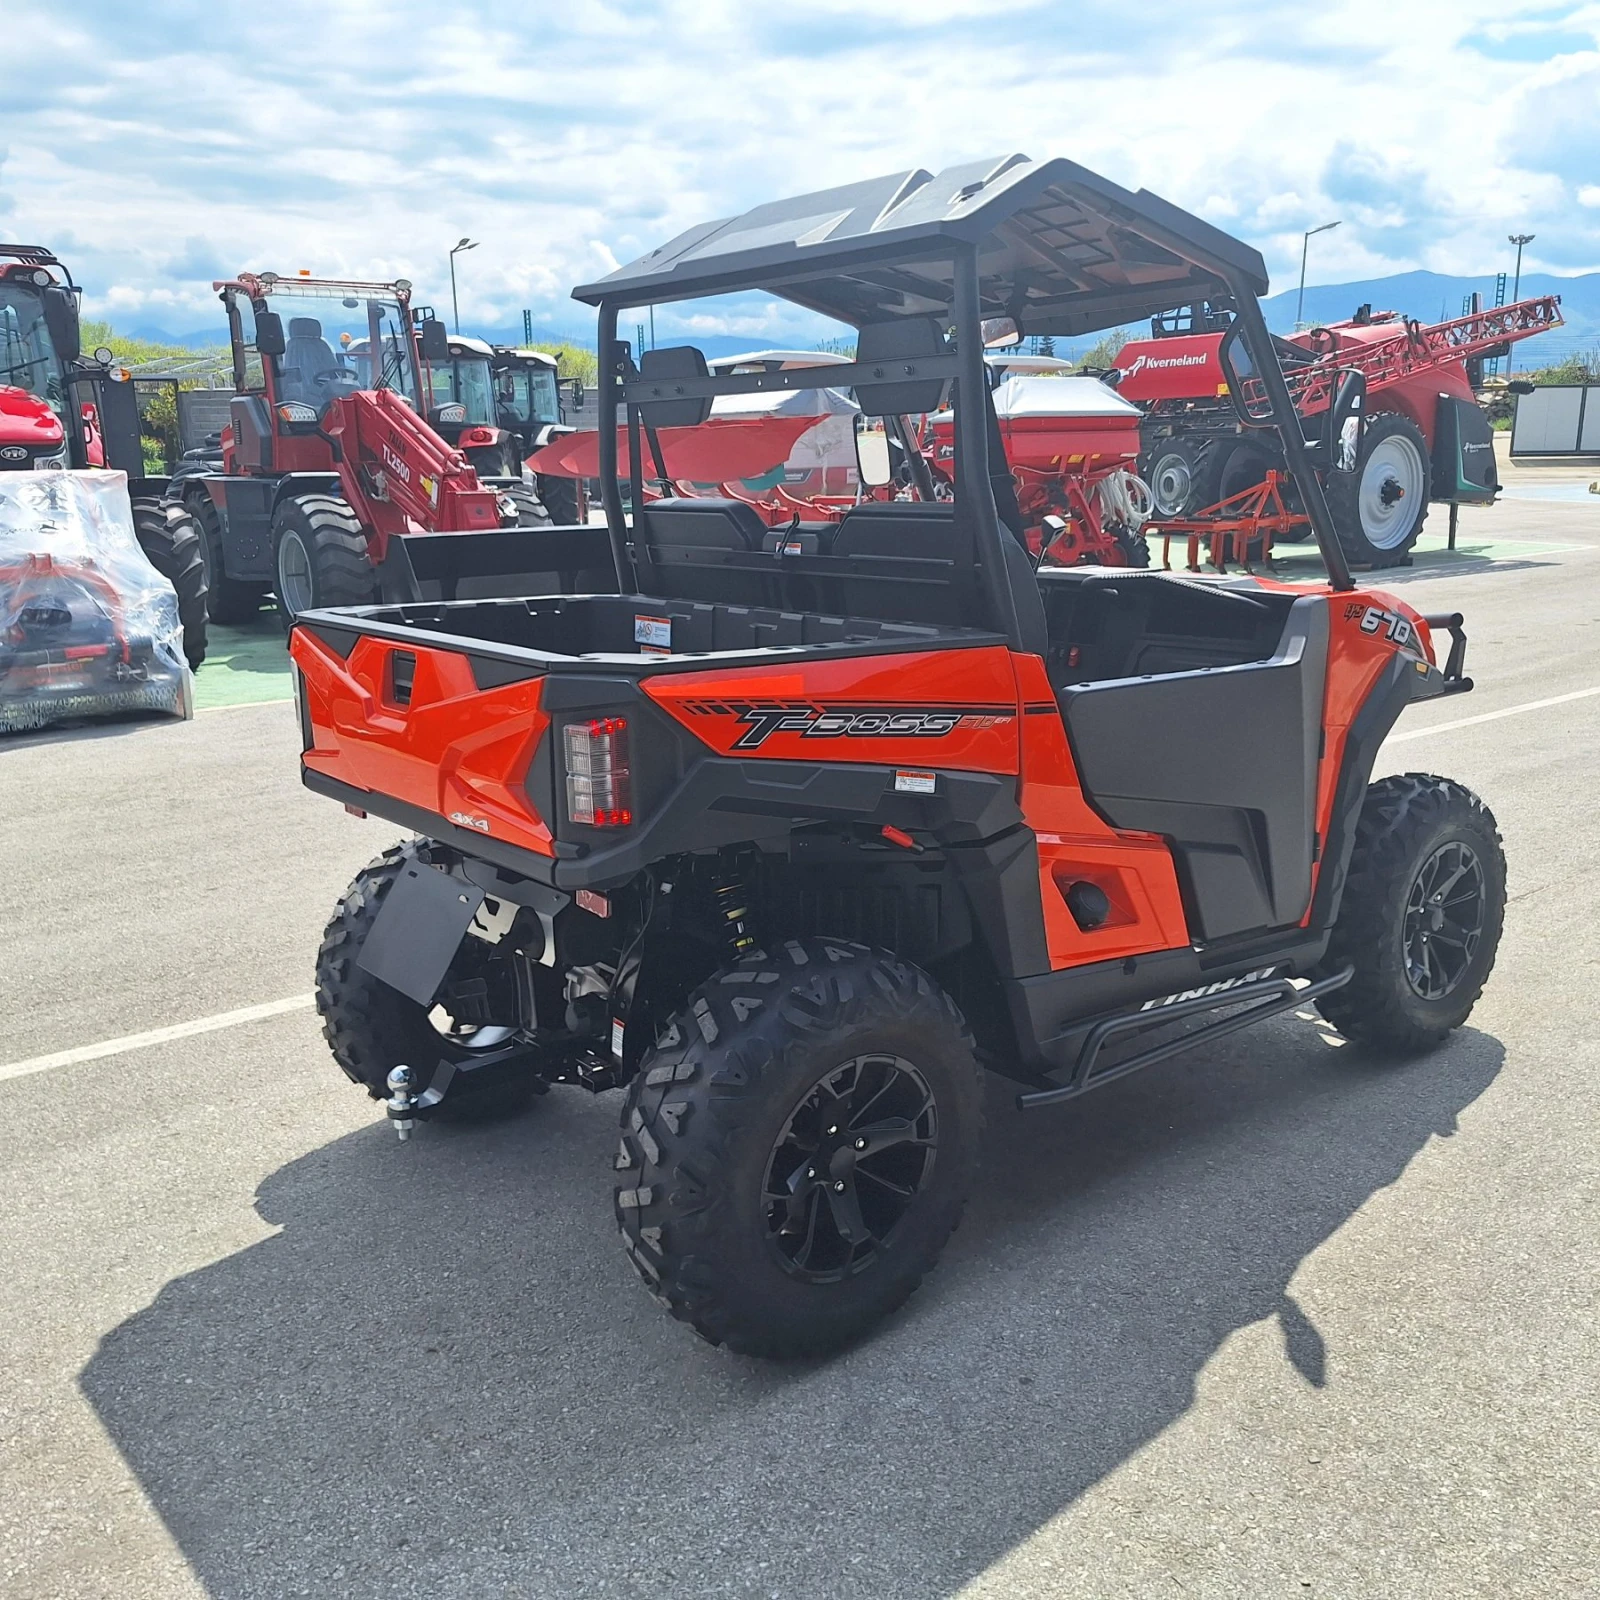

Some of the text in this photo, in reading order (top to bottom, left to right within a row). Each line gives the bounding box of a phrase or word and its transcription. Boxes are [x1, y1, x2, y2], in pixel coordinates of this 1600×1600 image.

[1146, 353, 1207, 369] Kverneland
[382, 443, 410, 483] TL2500
[1360, 606, 1411, 646] 670
[734, 709, 962, 748] T-BOSS
[1140, 966, 1276, 1012] LINHAI
